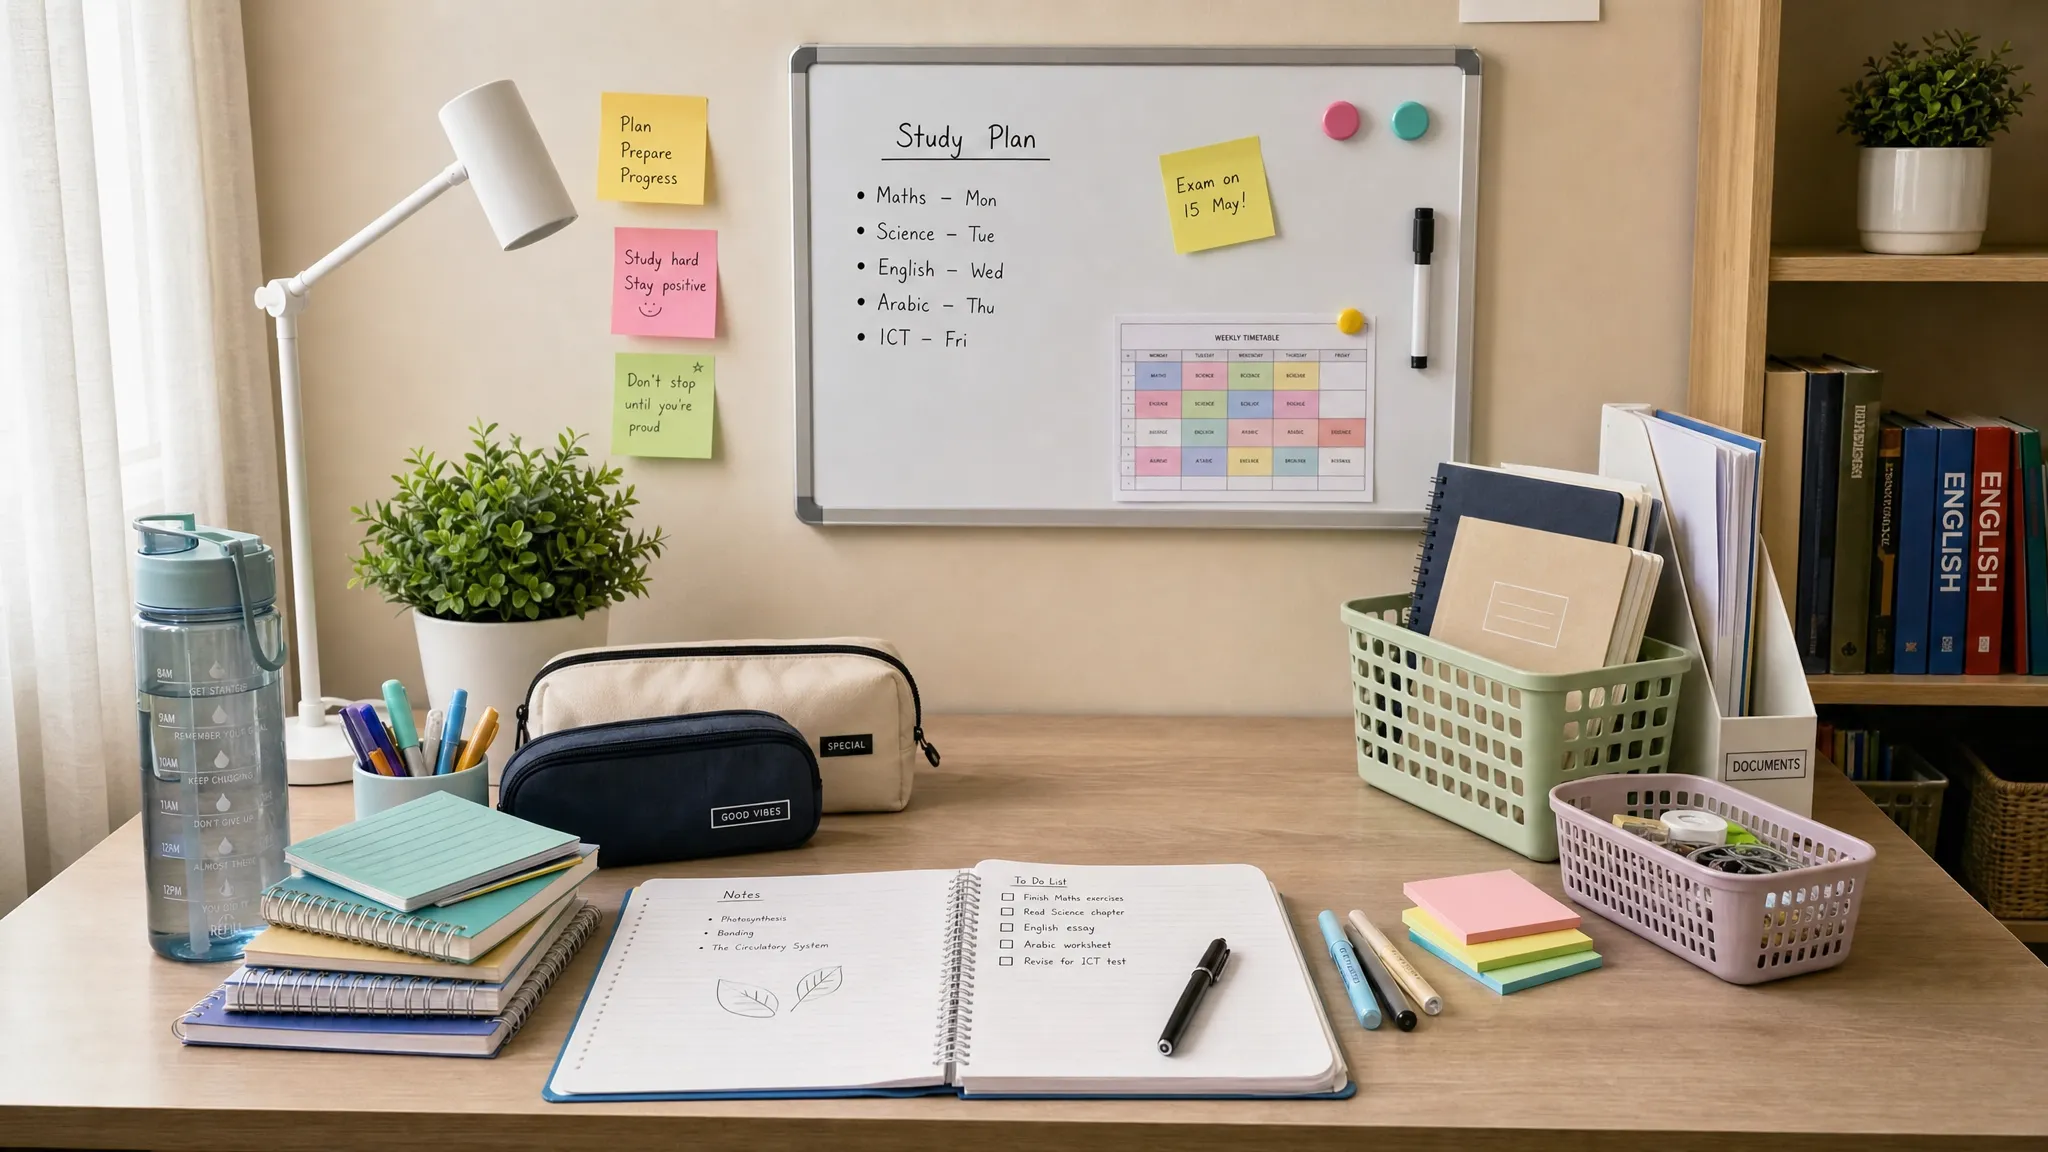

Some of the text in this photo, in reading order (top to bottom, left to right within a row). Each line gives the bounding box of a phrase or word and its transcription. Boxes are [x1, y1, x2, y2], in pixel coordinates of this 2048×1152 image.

[620, 115, 652, 133] Plan
[896, 122, 1036, 159] Study Plan
[621, 141, 672, 165] Prepare
[620, 166, 678, 190] Progress
[1176, 174, 1240, 194] Exam on
[876, 185, 927, 205] Maths
[965, 189, 997, 207] Mon
[1184, 191, 1246, 218] 15 May!
[876, 221, 935, 241] Science
[968, 225, 995, 243] Tue
[624, 248, 699, 272] Study hard
[878, 257, 935, 284] English
[971, 262, 1004, 280] Wed
[624, 274, 707, 297] Stay positive
[877, 292, 930, 313] Arabic
[966, 297, 995, 315] Thu
[880, 327, 911, 346] ICT
[945, 330, 967, 348] Fri
[1214, 334, 1279, 342] WEEKLY TIMETABLE
[627, 372, 696, 395] Don't stop
[625, 397, 692, 417] until you're
[629, 420, 661, 437] proud
[1939, 472, 1966, 592] ENGLISH
[1976, 471, 2002, 592] ENGLISH
[157, 668, 173, 678] 8AM
[189, 687, 206, 696] GET
[158, 713, 175, 724] 9AM
[174, 731, 220, 740] REMEMBER
[827, 740, 866, 751] SPECIAL
[1732, 757, 1801, 773] DOCUMENTS
[188, 776, 209, 785] KEEP
[160, 800, 178, 811] 11AM
[222, 817, 240, 826] GIVE
[721, 806, 781, 822] GOOD VIBES
[1014, 875, 1066, 886] To Do List
[723, 890, 760, 899] Notes
[1023, 893, 1049, 902] Finish
[1054, 894, 1081, 902] Maths
[721, 915, 787, 924] Photosynthesis
[1023, 907, 1125, 918] Read Science chapter
[717, 929, 754, 939] Bonding
[1023, 923, 1095, 936] English essay
[734, 943, 787, 953] Circulatory
[793, 942, 829, 952] System
[1023, 940, 1112, 949] Arabic worksheet
[1024, 956, 1126, 966] Revise for ICT test
